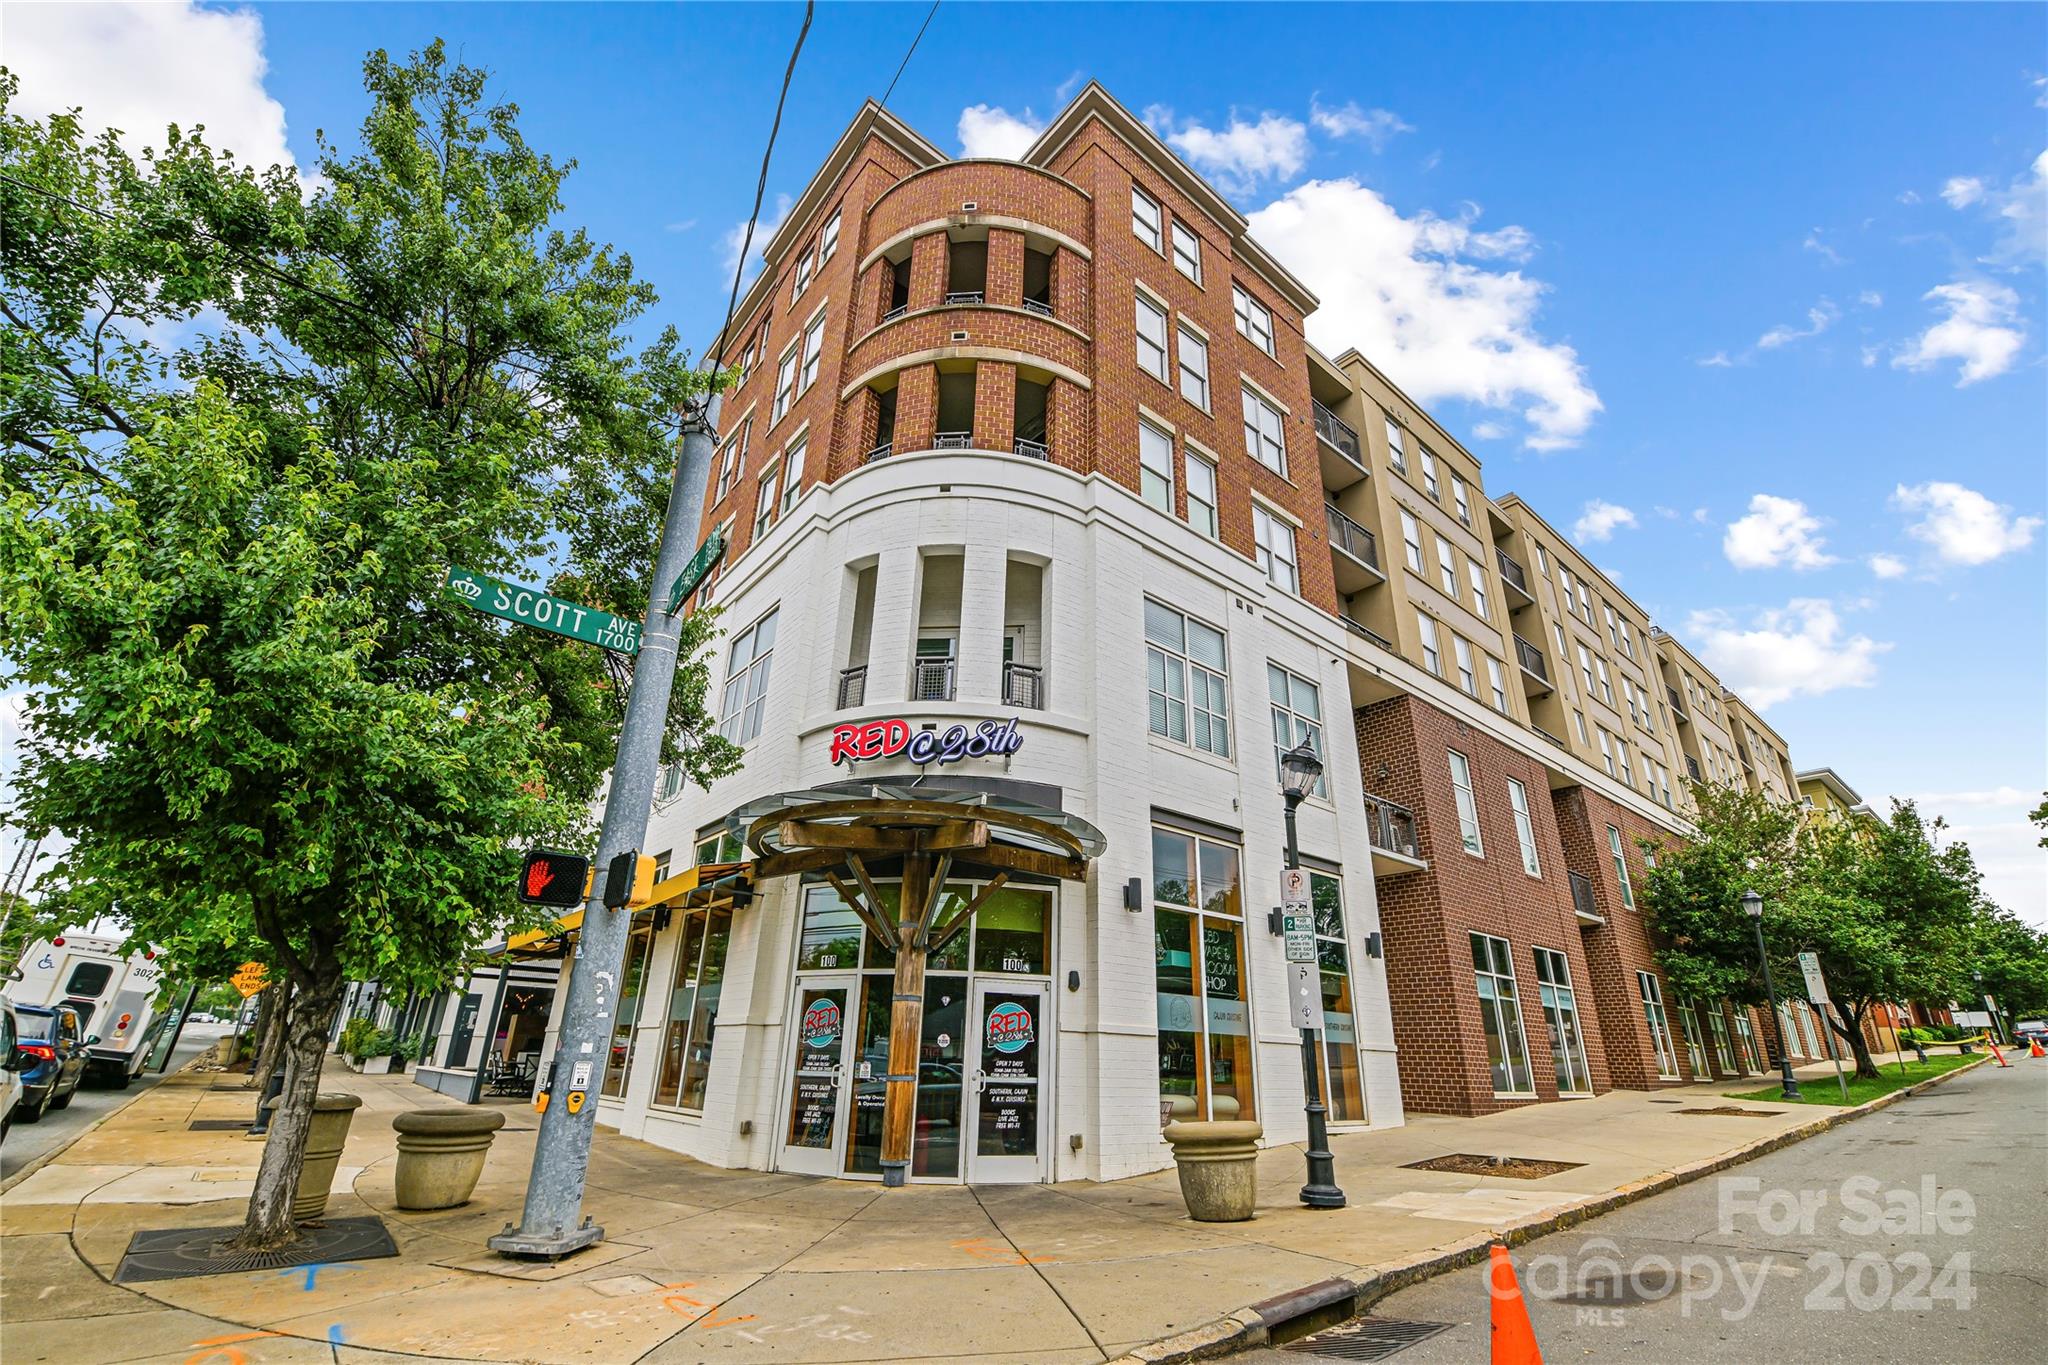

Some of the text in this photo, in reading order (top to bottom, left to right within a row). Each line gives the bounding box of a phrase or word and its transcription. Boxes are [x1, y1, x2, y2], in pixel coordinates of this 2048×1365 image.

[493, 585, 638, 638] SCOTT AVE
[595, 628, 635, 651] 1700
[830, 718, 912, 766] RED
[937, 716, 1024, 766] 28th
[1287, 919, 1294, 929] 2
[822, 955, 836, 967] 100
[1005, 959, 1022, 970] 100
[240, 982, 261, 990] ENDS
[806, 1006, 839, 1030] RED
[990, 1010, 1031, 1036] RED
